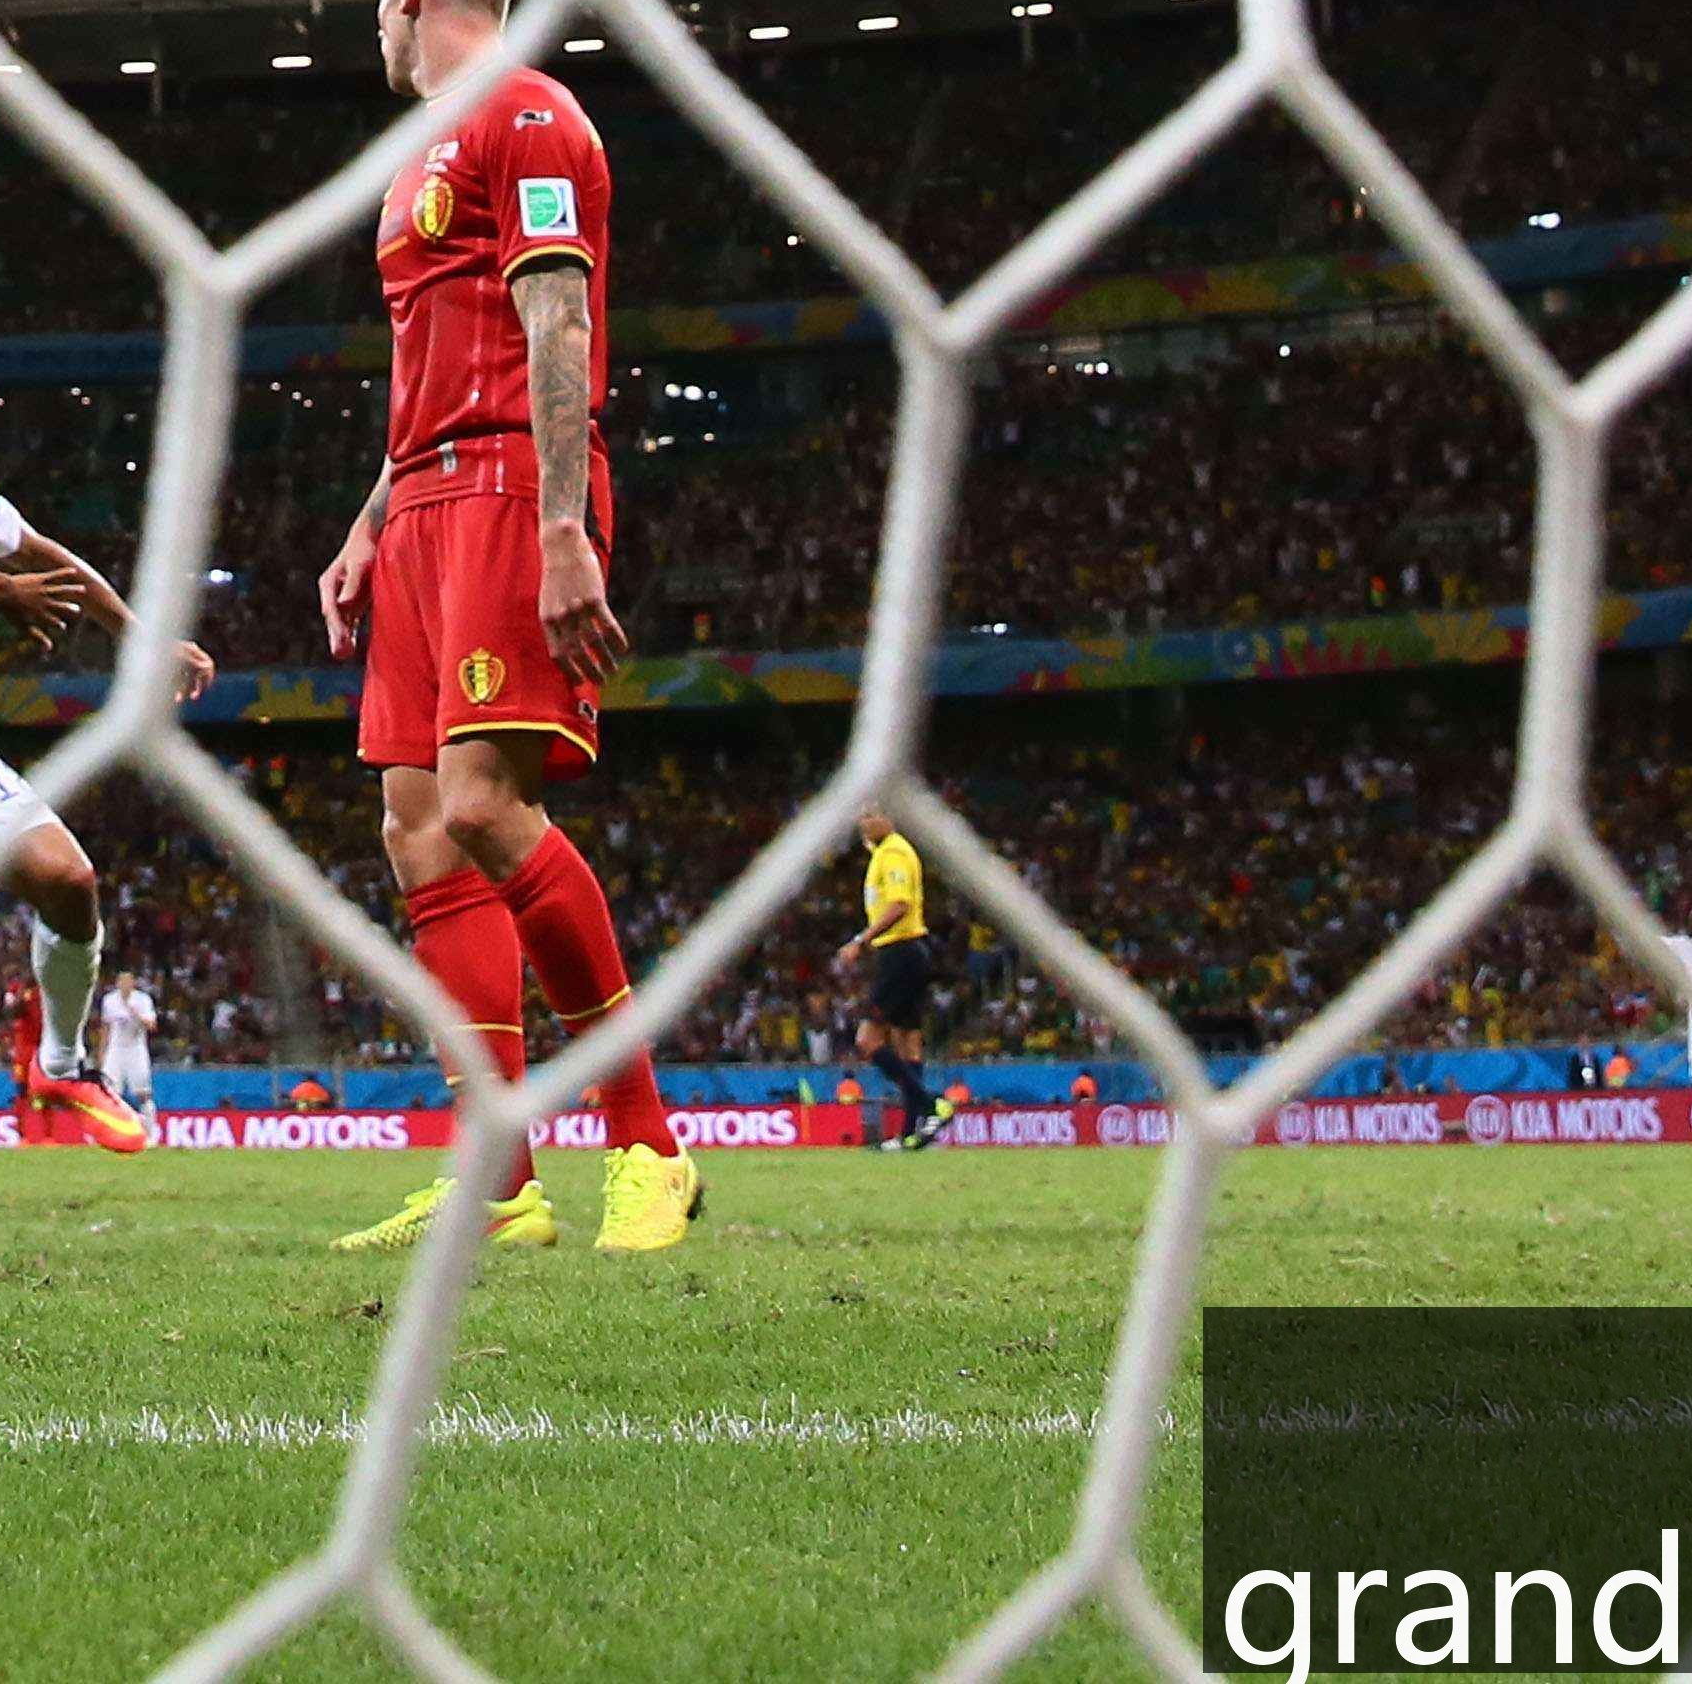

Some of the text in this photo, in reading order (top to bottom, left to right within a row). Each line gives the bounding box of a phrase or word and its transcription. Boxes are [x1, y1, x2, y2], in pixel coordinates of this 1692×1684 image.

[166, 1114, 409, 1149] KIA MOTORS
[666, 1110, 798, 1146] OTORS
[992, 1111, 1077, 1144] MOTORS
[1314, 1101, 1440, 1142] KIA MOTORS
[1510, 1099, 1554, 1141] KIA
[1557, 1096, 1663, 1142] MOTORS
